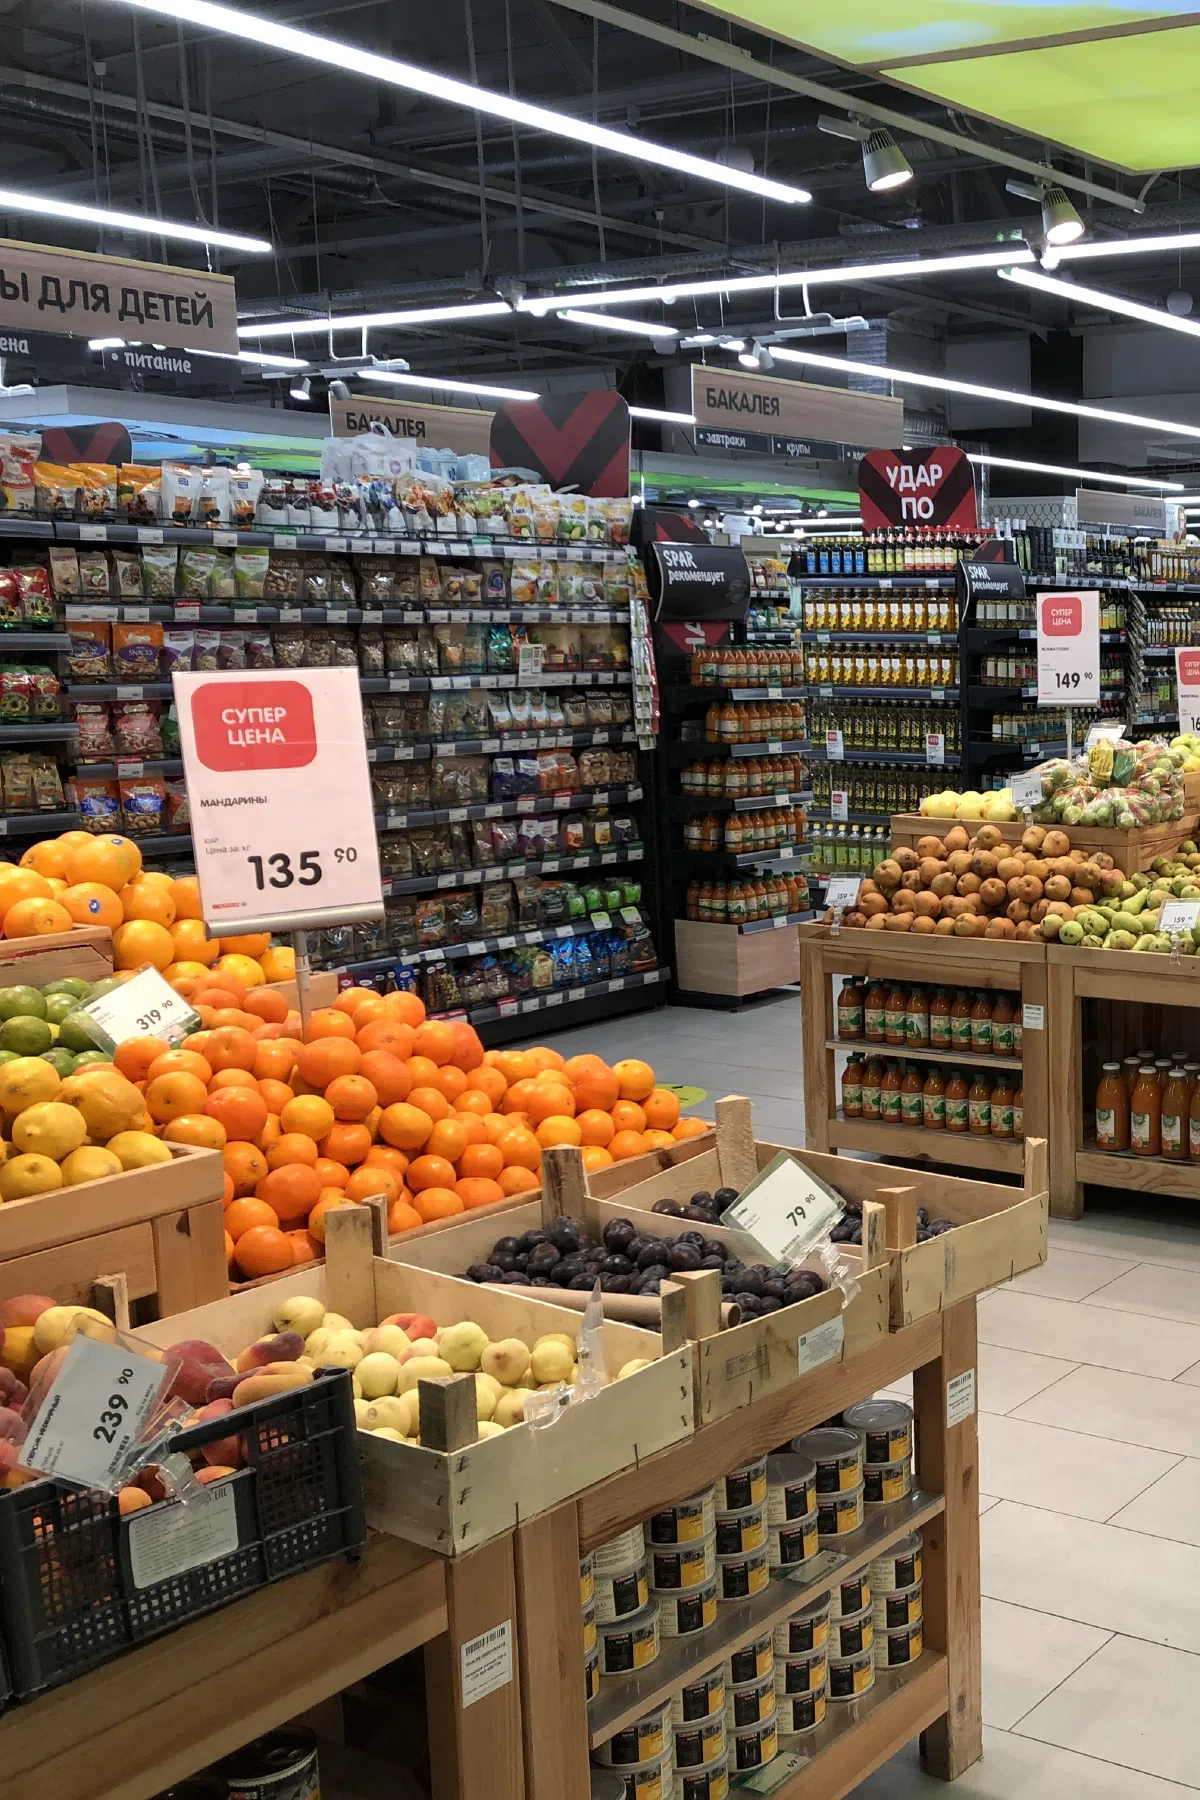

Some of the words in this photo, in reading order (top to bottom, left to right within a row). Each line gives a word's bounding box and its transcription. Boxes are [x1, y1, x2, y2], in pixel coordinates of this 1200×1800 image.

[38, 275, 111, 314] ДЛЯ
[117, 287, 214, 328] ДЕТЕЙ
[124, 351, 192, 374] питание
[706, 387, 780, 417] БАКАЛЕЯ
[345, 411, 426, 438] БАКАЛЕЯ
[706, 432, 746, 449] завтраки
[786, 442, 811, 457] крупы
[885, 463, 943, 492] УДАР
[901, 496, 935, 520] ПО
[1133, 506, 1162, 518] БАКАЛЕЯ
[662, 549, 698, 569] SPAR
[668, 569, 725, 586] рекомендует
[968, 565, 991, 580] SPAR
[971, 580, 1009, 594] рекомендует
[1051, 608, 1073, 617] СУПЕР
[1052, 618, 1072, 626] ЦЕНА
[1055, 672, 1081, 688] 149
[1084, 672, 1093, 680] 90
[221, 706, 287, 725] СУПЕР
[227, 728, 286, 748] ЦЕНА
[200, 796, 268, 808] МАНДАРИНЫ
[205, 845, 227, 855] Цена
[247, 850, 322, 891] 135
[333, 847, 358, 864] 90
[136, 1009, 162, 1030] 319
[161, 999, 174, 1010] 90
[786, 1205, 807, 1227] 79
[804, 1193, 816, 1205] 90
[93, 1393, 129, 1444] 239
[118, 1368, 134, 1385] 90
[26, 1437, 42, 1465] ПЕРСИК
